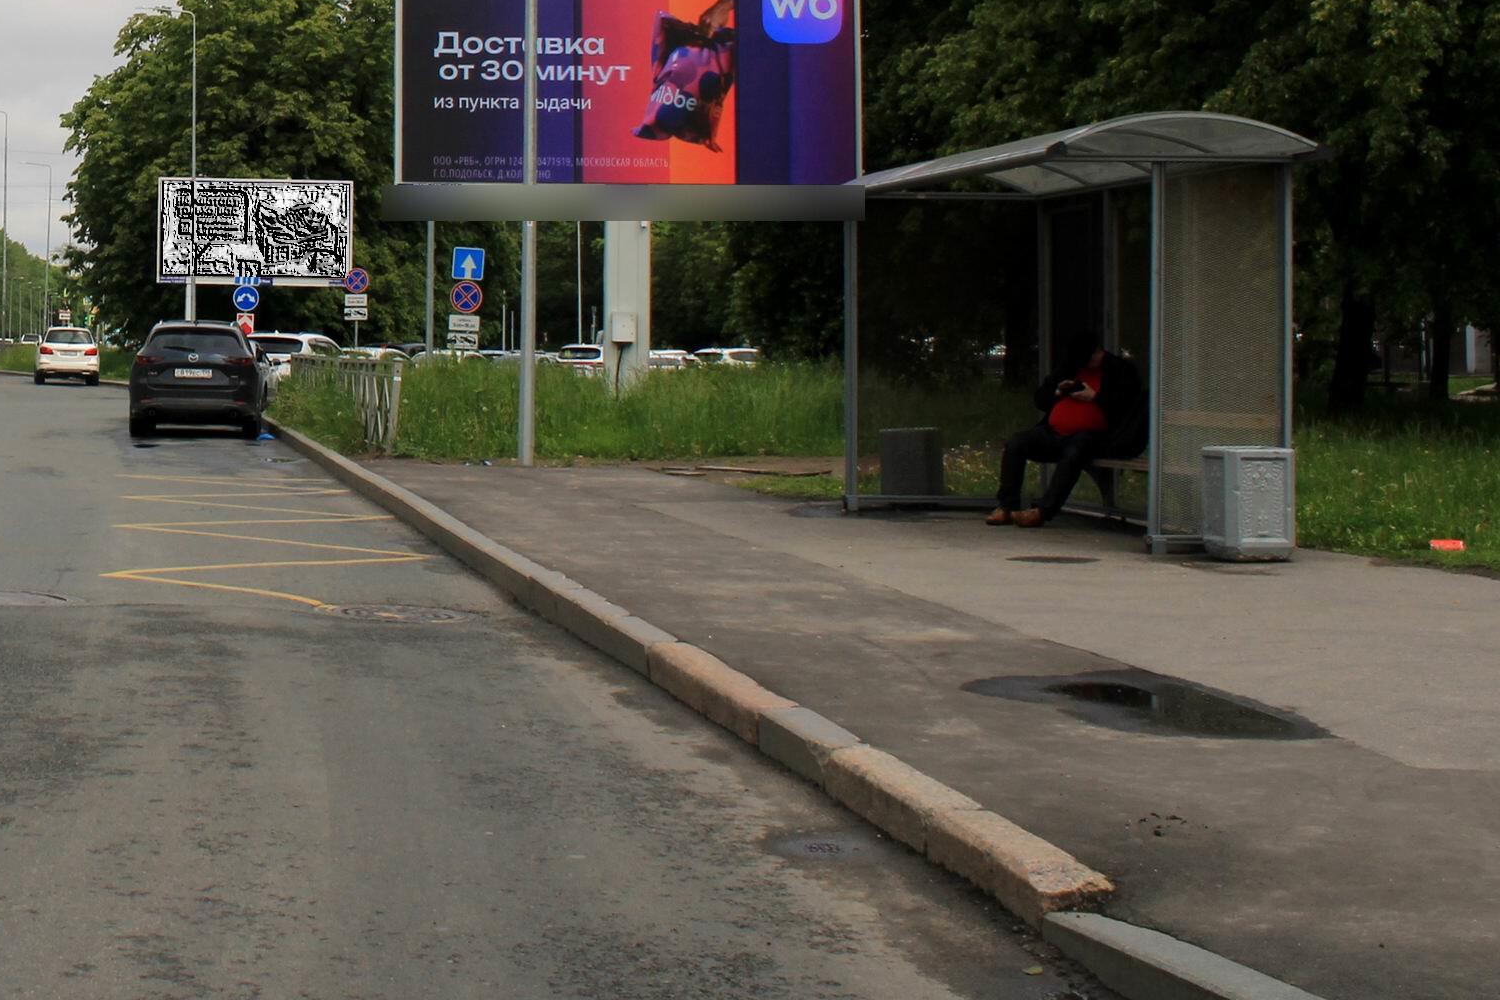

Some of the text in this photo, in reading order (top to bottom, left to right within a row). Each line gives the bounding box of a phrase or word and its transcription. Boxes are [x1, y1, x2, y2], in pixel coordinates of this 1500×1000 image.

[438, 60, 631, 86] от 30 минут
[433, 96, 592, 113] из пункта ыдачи
[433, 156, 452, 166] ООО
[484, 156, 506, 166] ОГРН
[575, 157, 630, 168] МОСКОВСКАЯ
